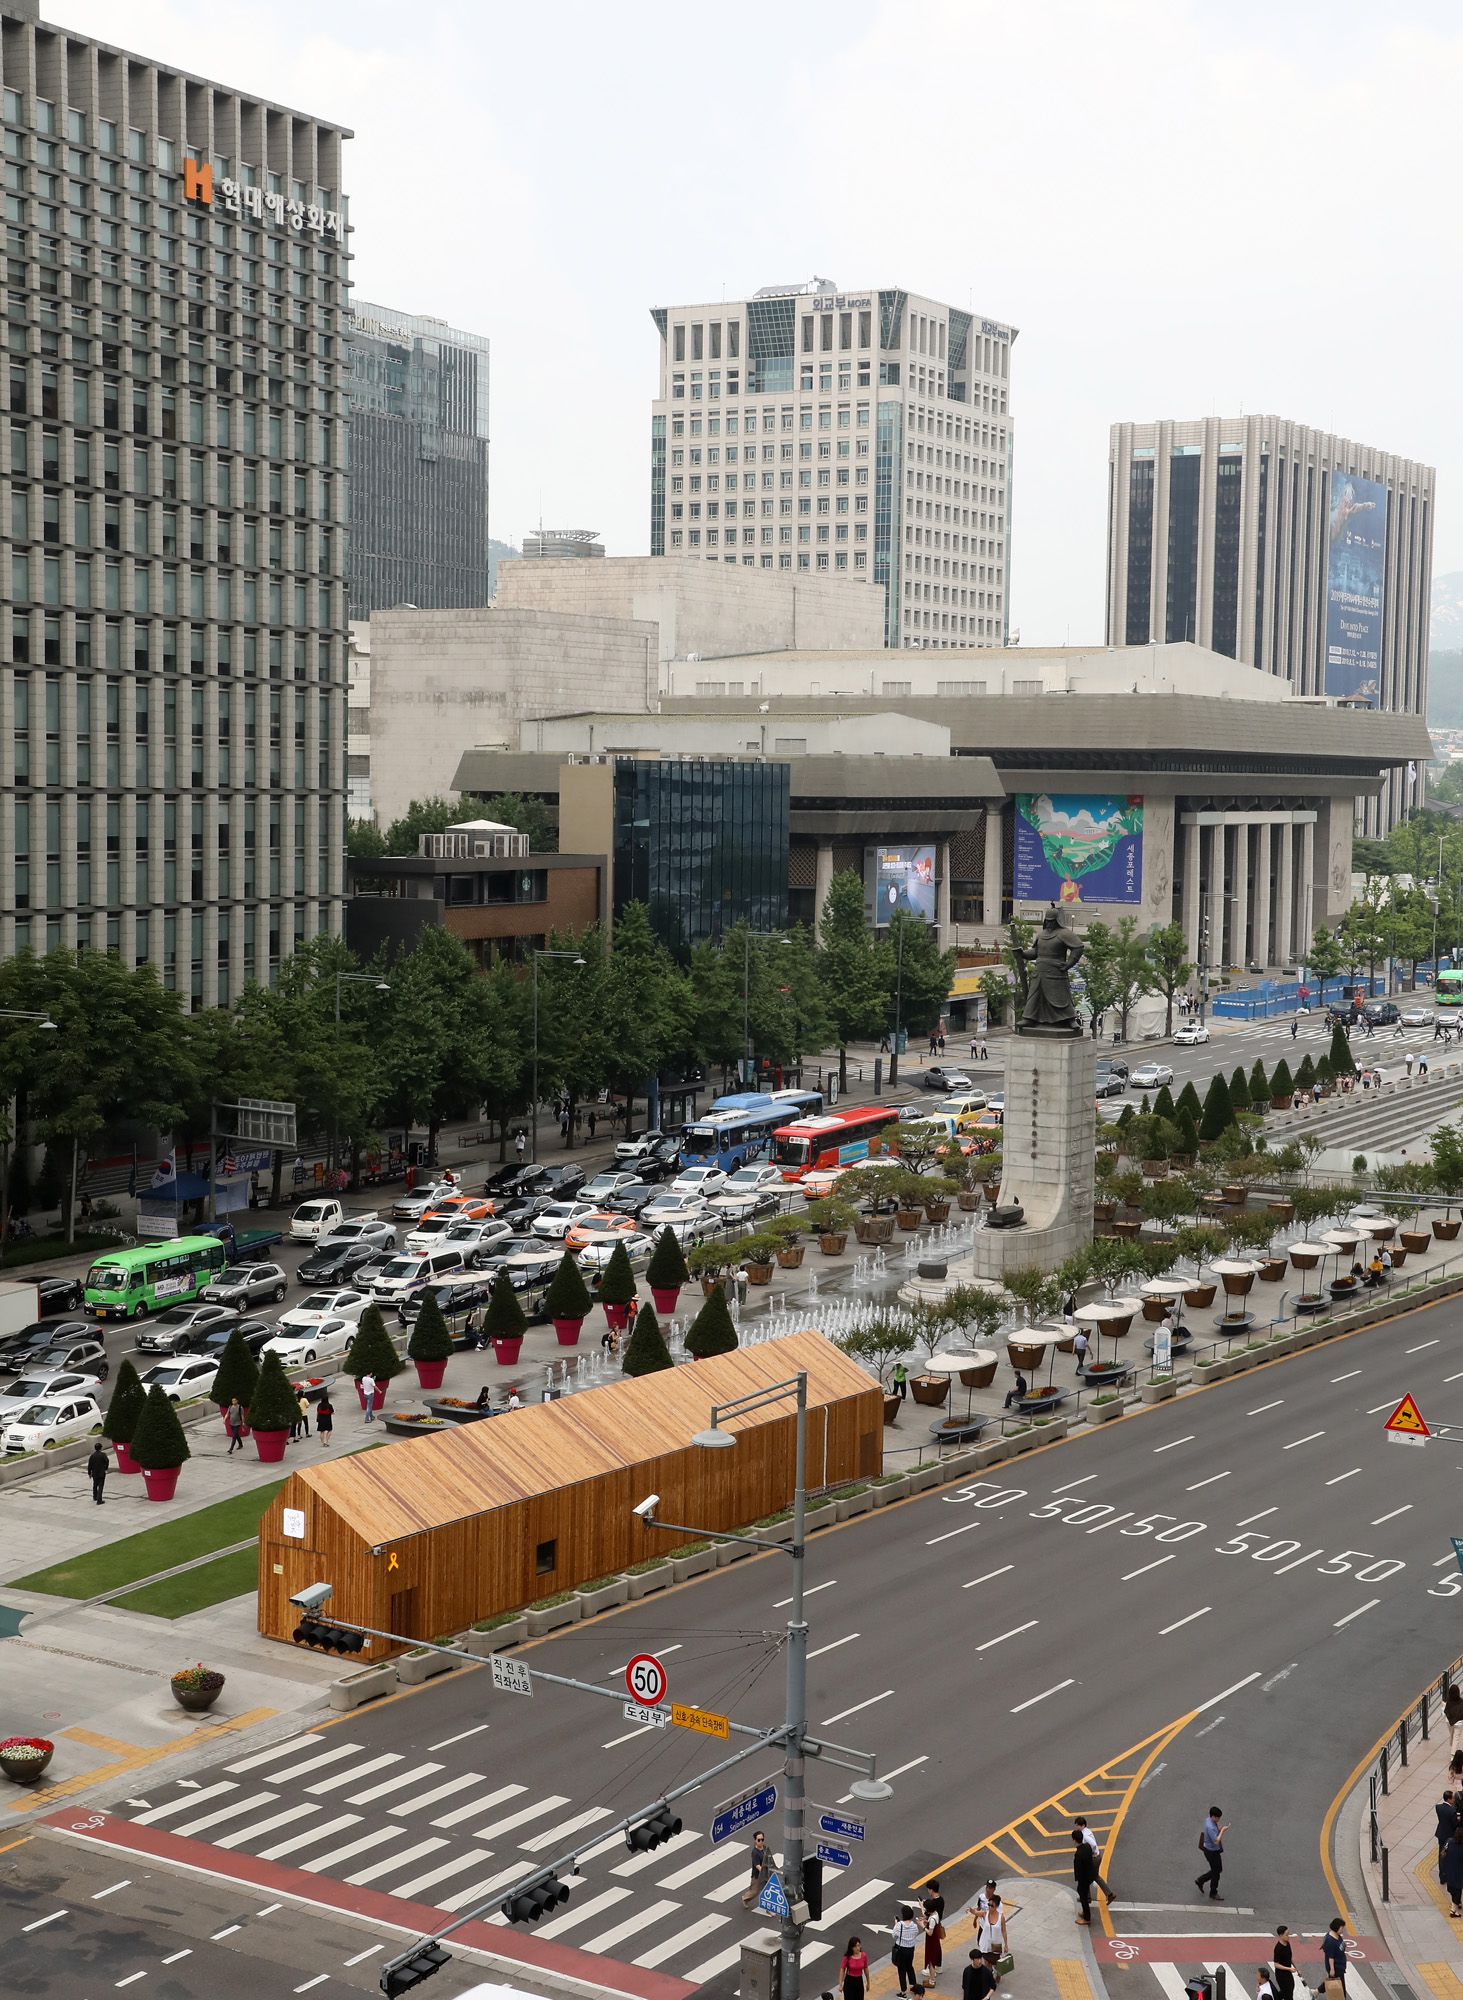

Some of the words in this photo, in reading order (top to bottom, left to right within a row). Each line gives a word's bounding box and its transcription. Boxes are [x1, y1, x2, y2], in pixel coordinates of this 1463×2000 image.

[221, 177, 344, 243] 현대해상화재
[812, 295, 846, 311] 외교부
[847, 298, 871, 308] MOFA
[1126, 843, 1135, 893] 세종포레스트
[942, 1482, 1028, 1509] 50
[1029, 1497, 1115, 1525] 50
[1120, 1514, 1207, 1542] 50
[1215, 1532, 1301, 1561] 50
[1317, 1551, 1406, 1582] 50
[494, 1673, 531, 1693] 직좌신호
[634, 1666, 658, 1694] 50
[626, 1706, 663, 1724] 도심부
[702, 1717, 725, 1733] 단속장비
[732, 1798, 758, 1819] 세종대로
[765, 1793, 775, 1806] 158
[714, 1822, 724, 1836] 154
[730, 1811, 760, 1833] Sejong-daero
